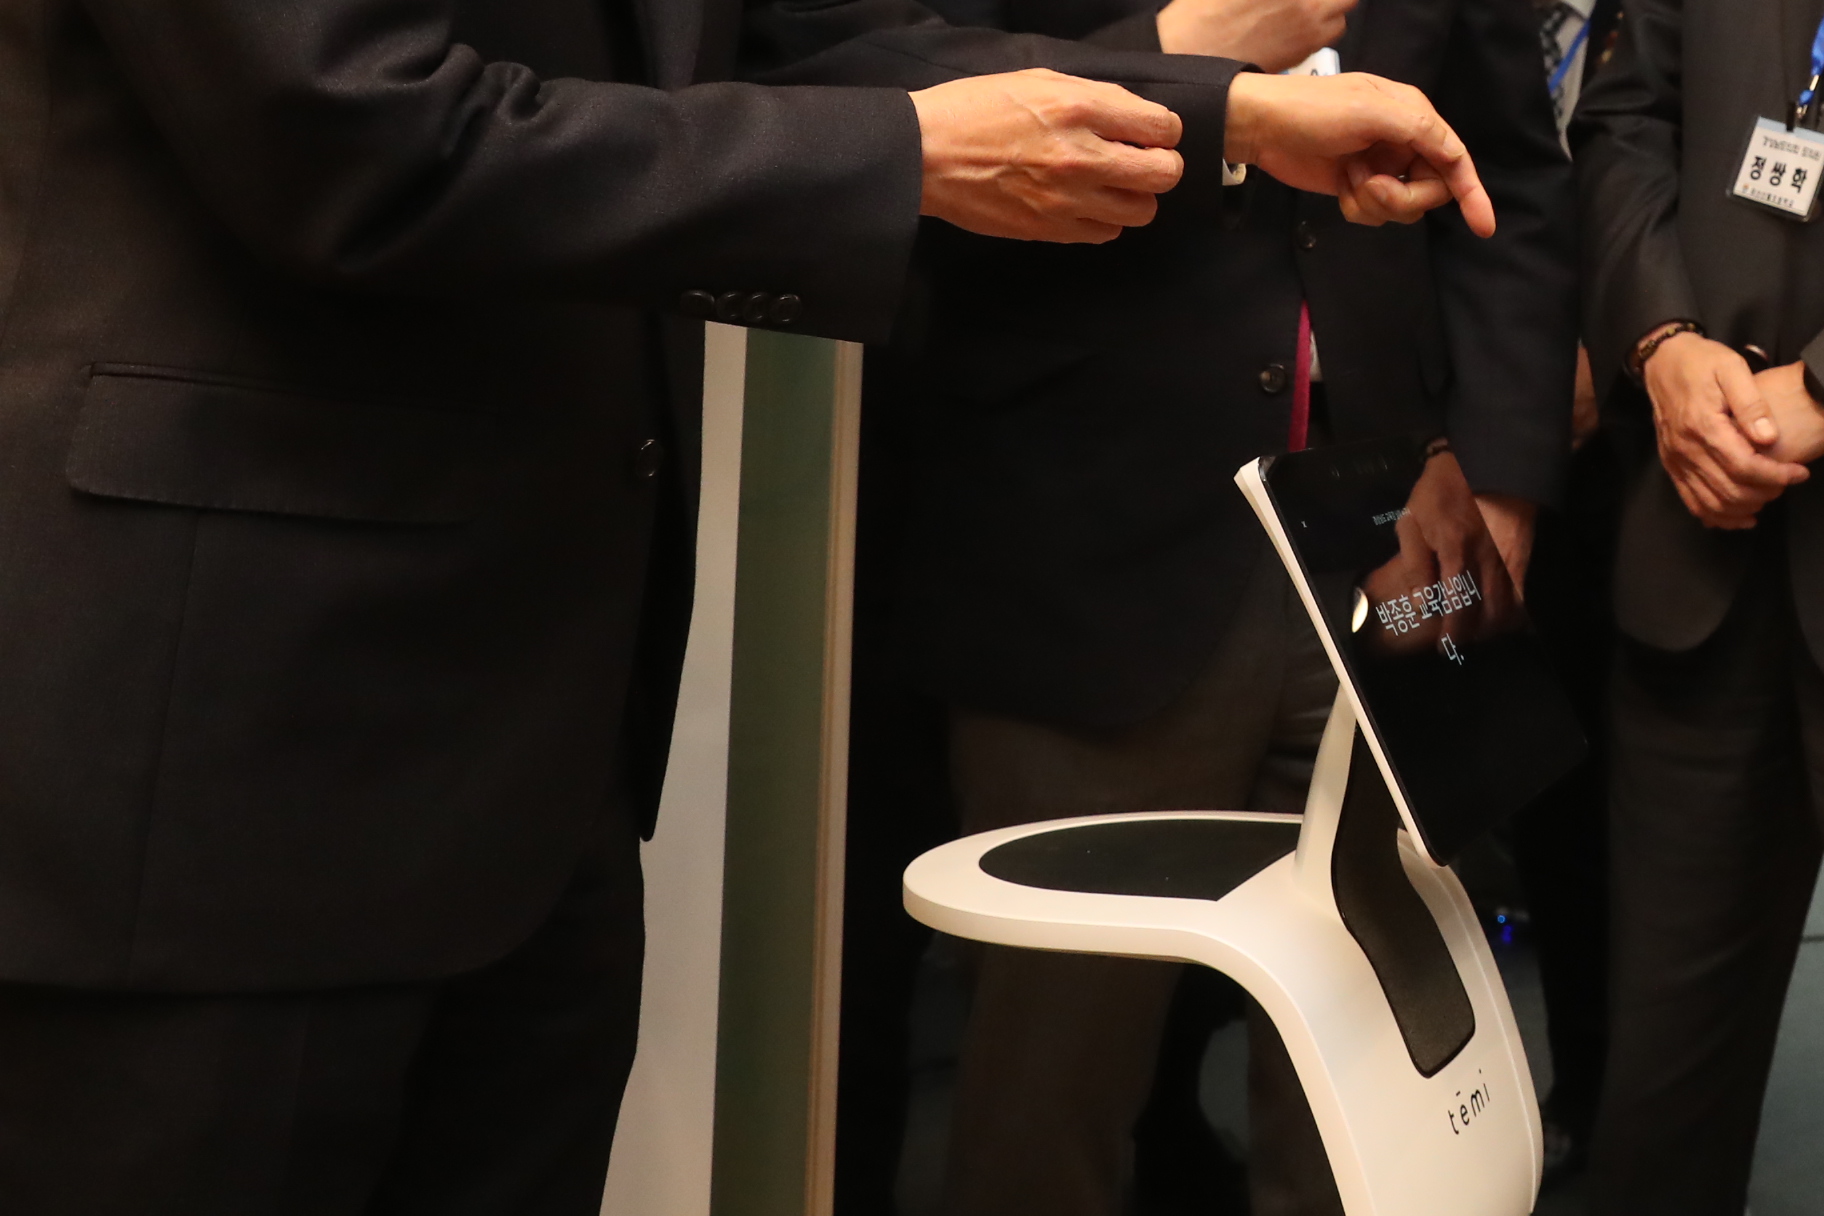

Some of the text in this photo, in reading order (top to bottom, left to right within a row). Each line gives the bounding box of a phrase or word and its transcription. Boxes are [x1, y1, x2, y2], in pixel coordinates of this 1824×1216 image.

[1375, 569, 1482, 636] 박종훈 교육감님입니
[1441, 632, 1465, 666] 다.
